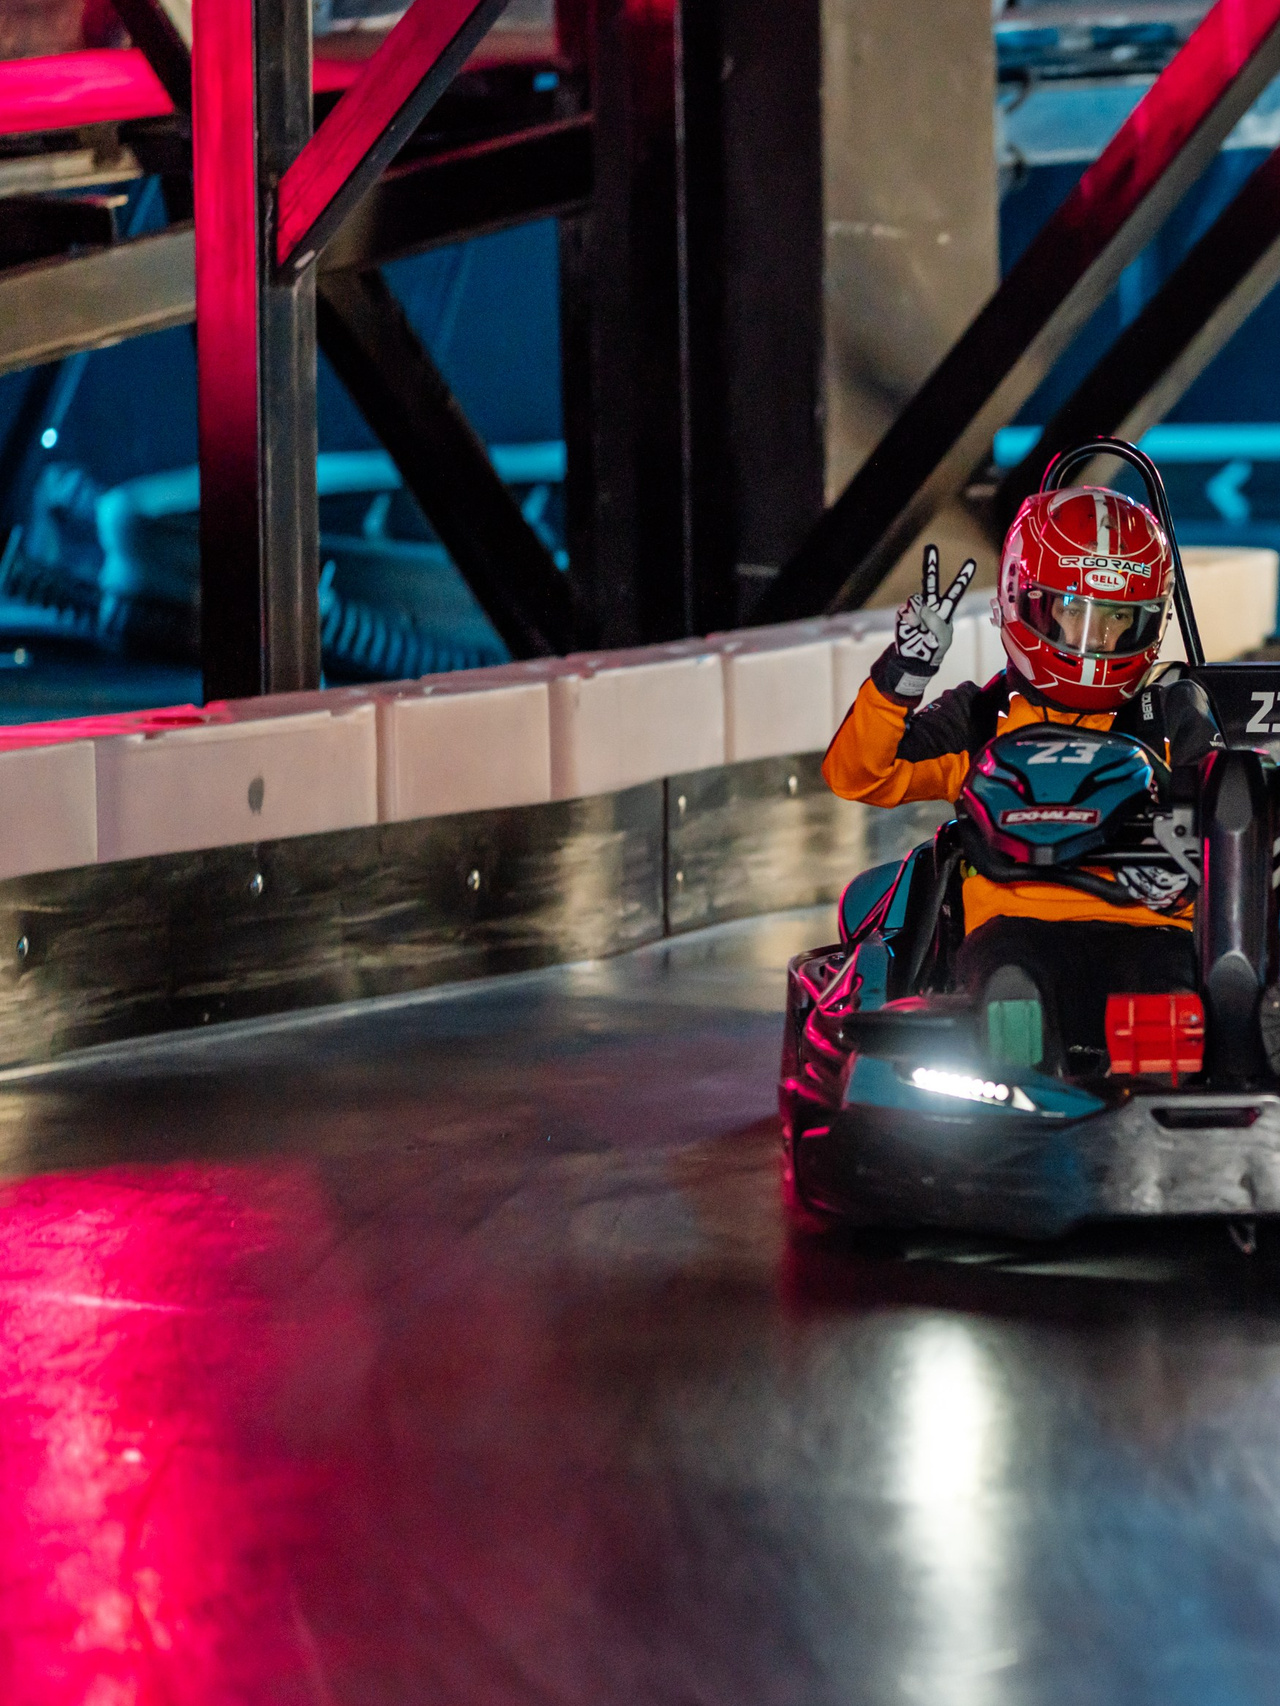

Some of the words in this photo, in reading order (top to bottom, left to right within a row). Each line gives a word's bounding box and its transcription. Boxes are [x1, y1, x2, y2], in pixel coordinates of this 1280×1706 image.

[1083, 557, 1108, 568] GO
[1111, 559, 1151, 577] RACE
[1091, 574, 1119, 586] BELL
[1026, 741, 1103, 765] 23
